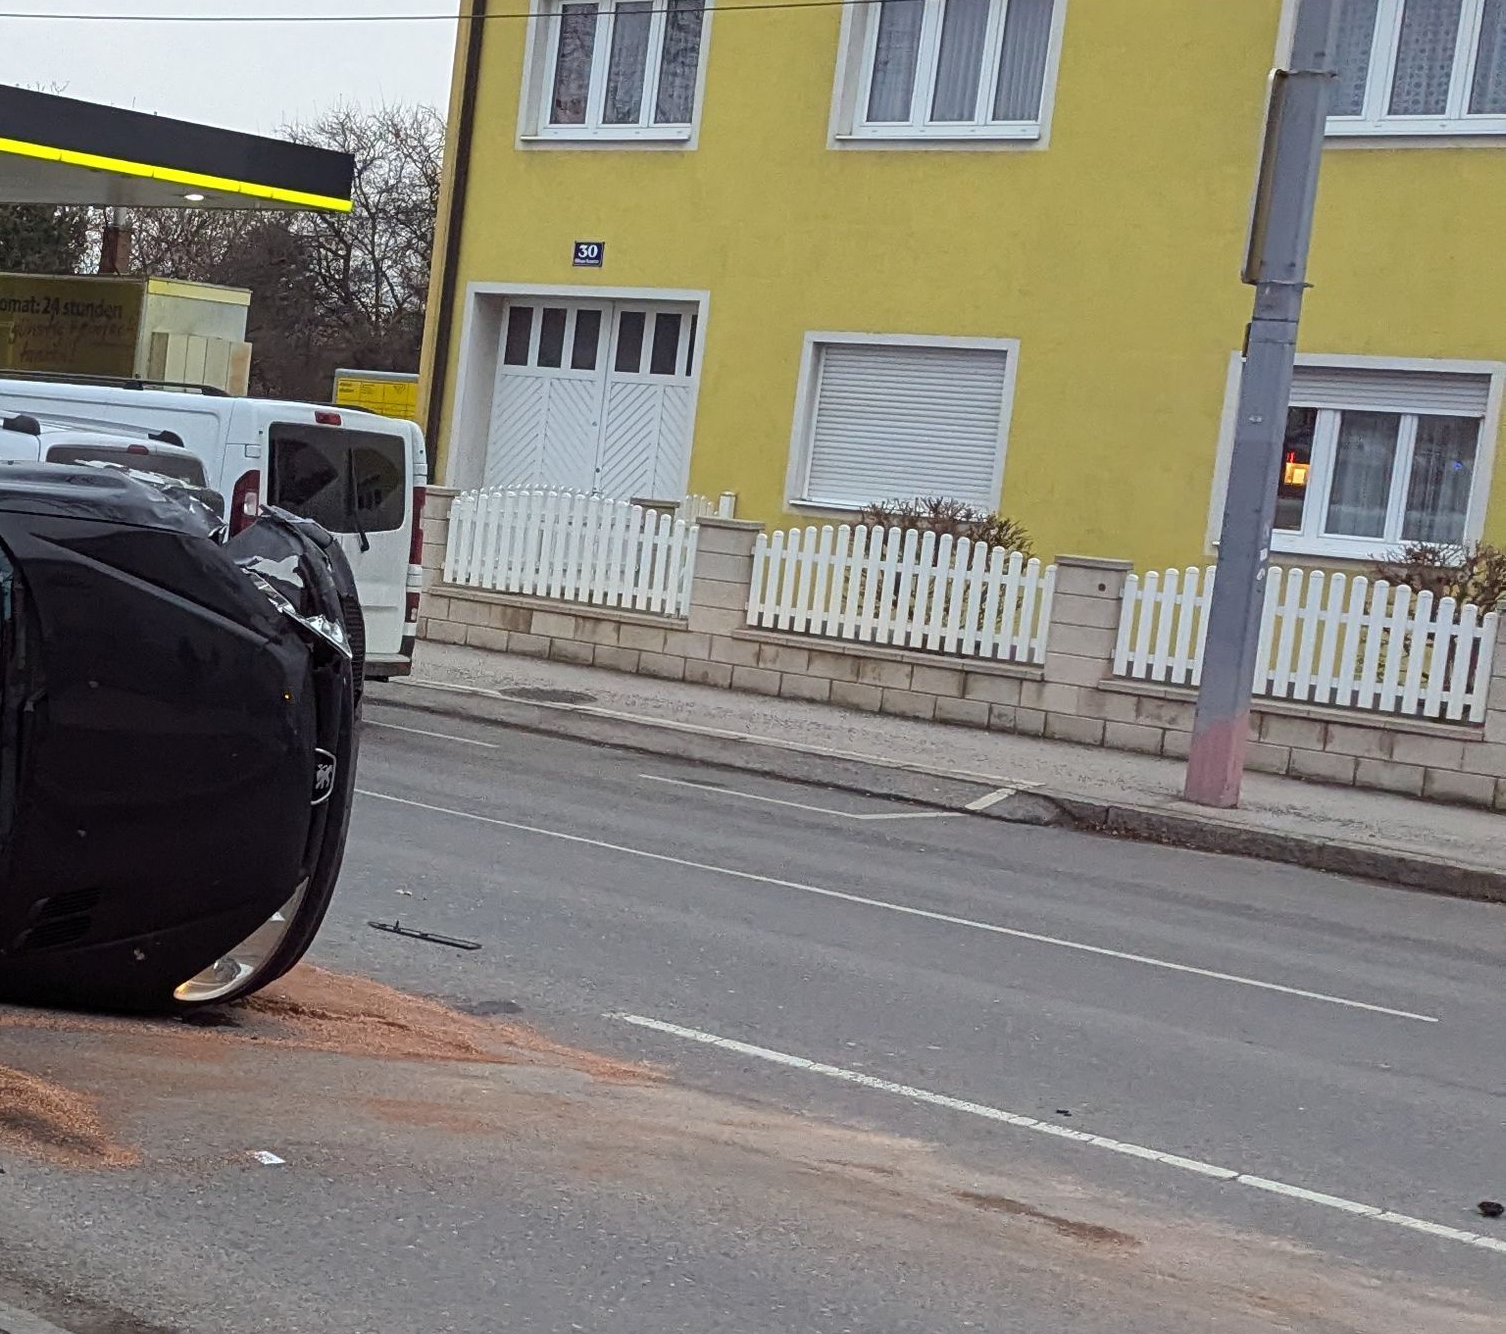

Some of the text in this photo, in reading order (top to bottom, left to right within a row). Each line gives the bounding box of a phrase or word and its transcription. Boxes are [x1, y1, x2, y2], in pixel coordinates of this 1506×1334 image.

[578, 244, 598, 258] 30
[41, 297, 60, 315] 24
[62, 299, 122, 320] stunden
